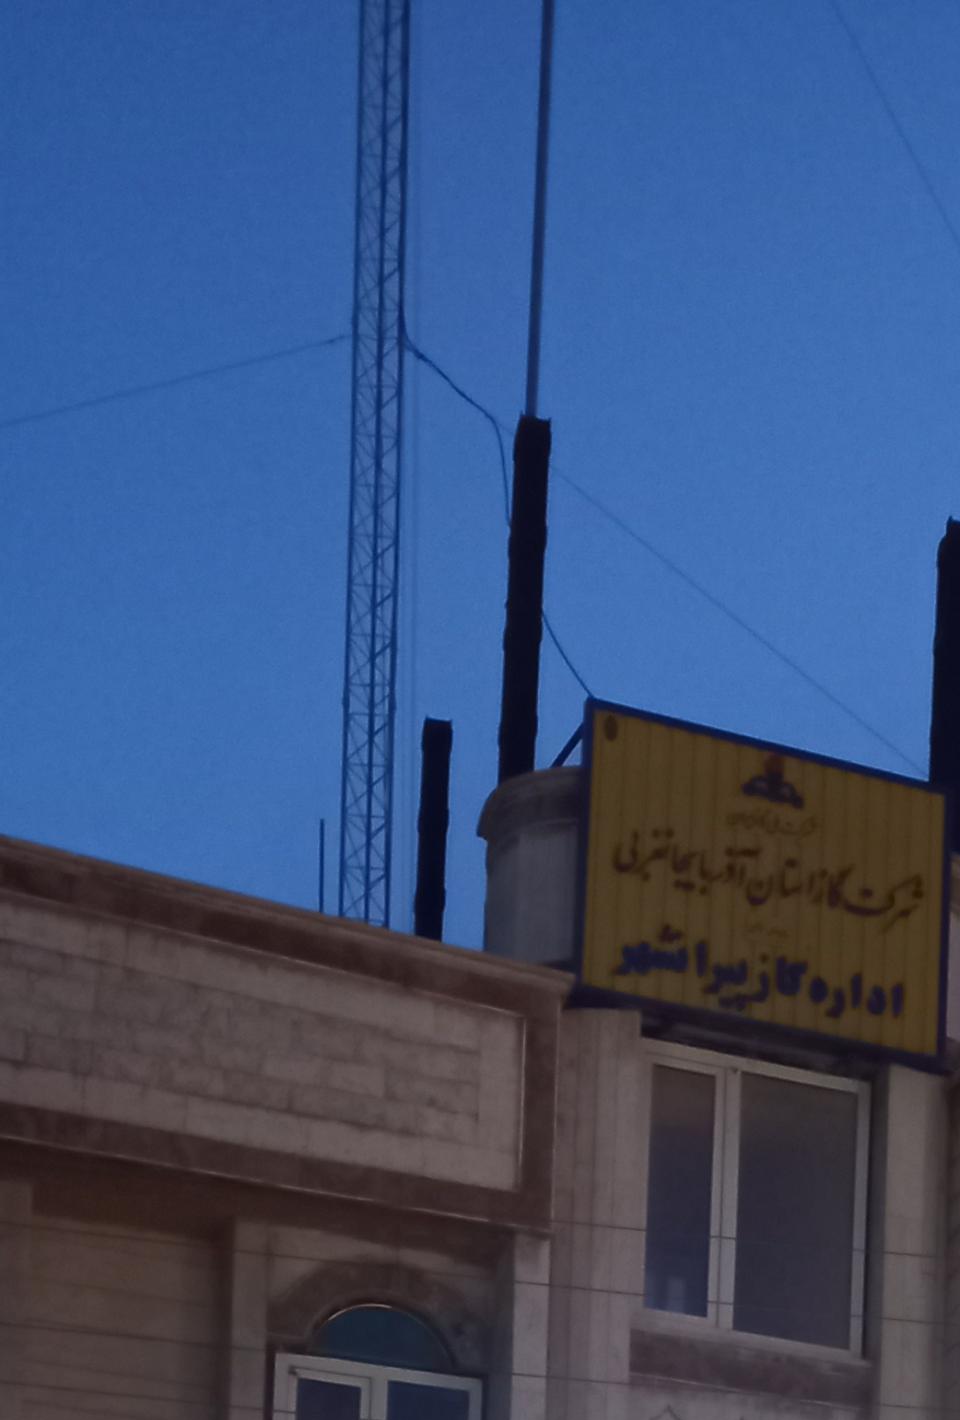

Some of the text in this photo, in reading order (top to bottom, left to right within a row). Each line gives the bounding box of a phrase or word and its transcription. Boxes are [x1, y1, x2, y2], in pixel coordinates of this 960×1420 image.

[745, 858, 815, 907] استان
[810, 863, 856, 909] گاز
[843, 873, 924, 934] شرکت
[611, 923, 748, 1012] پیرانشهر
[749, 951, 808, 1003] گاز
[808, 973, 905, 1019] اداره
